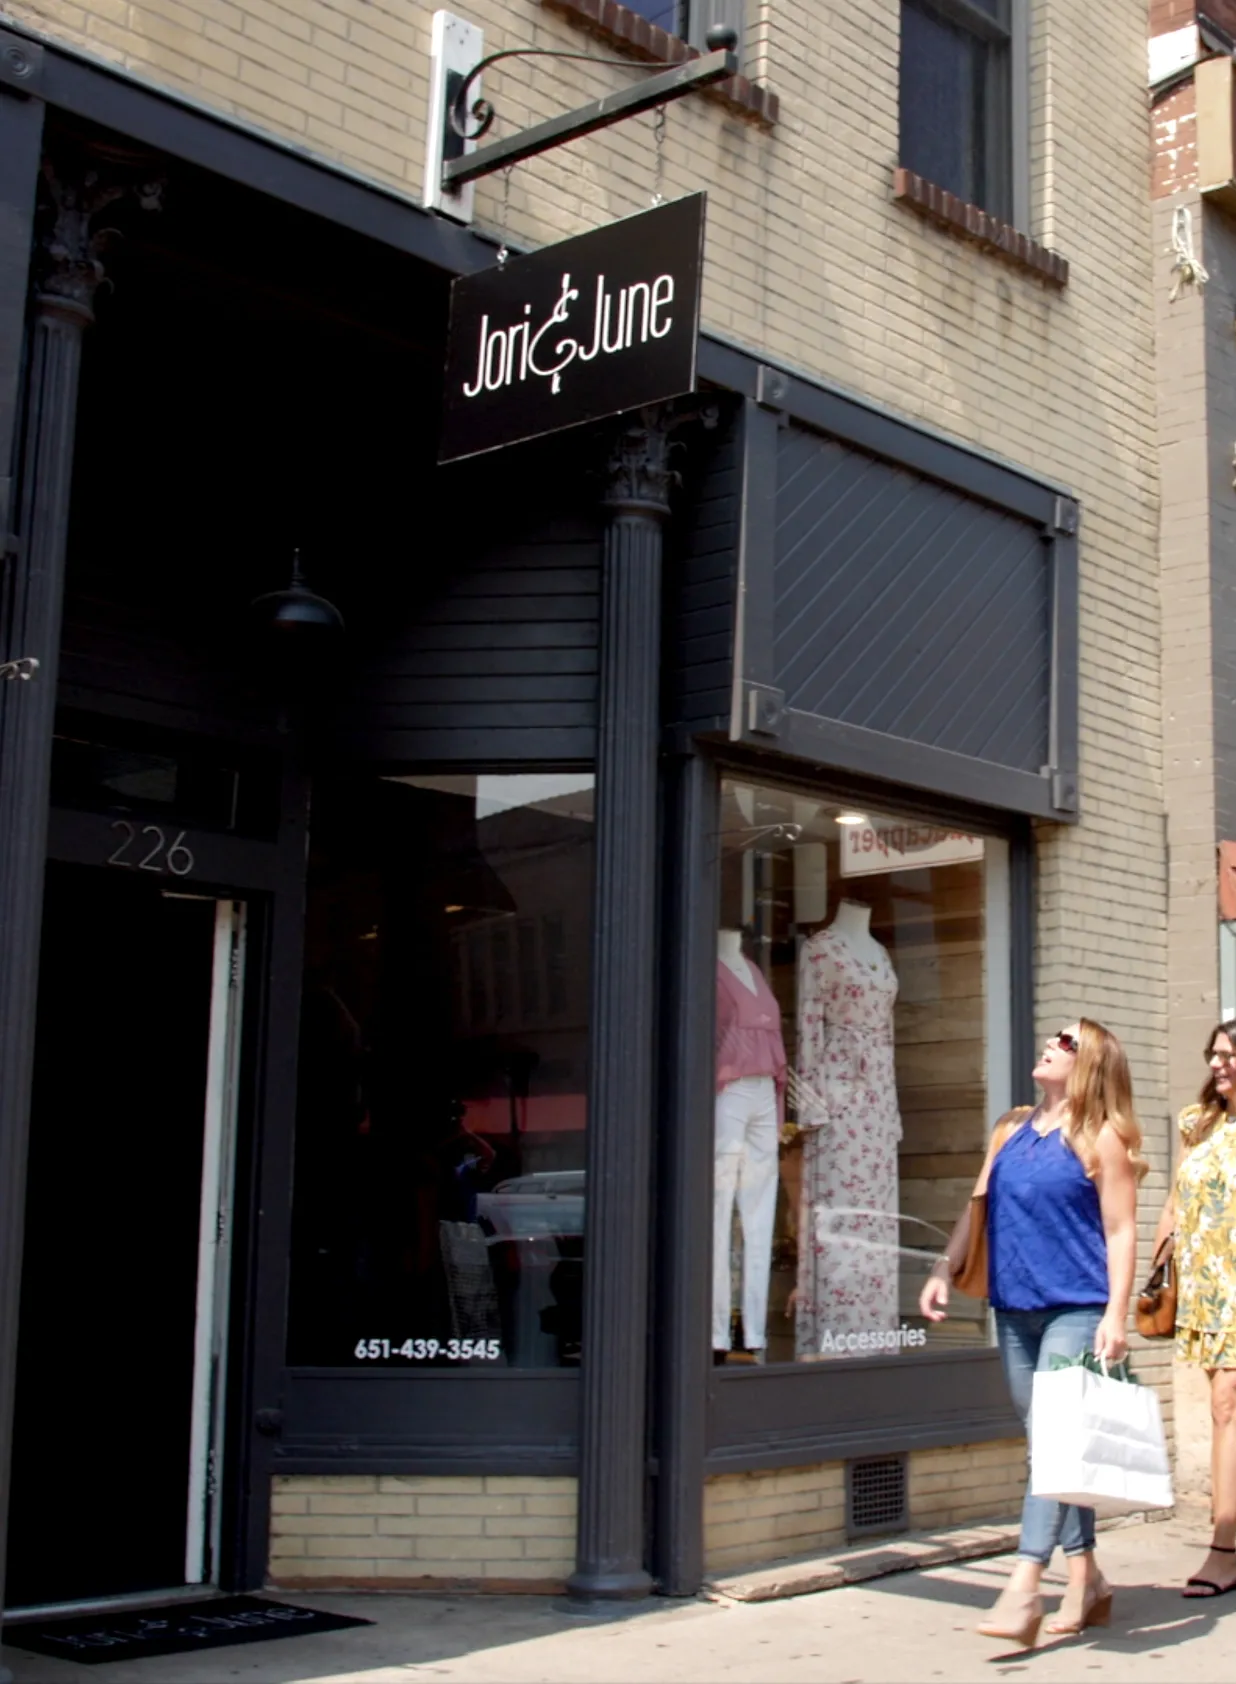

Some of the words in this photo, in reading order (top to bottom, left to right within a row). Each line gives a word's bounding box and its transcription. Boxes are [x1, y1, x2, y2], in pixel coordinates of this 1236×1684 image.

[463, 304, 531, 397] Jori
[578, 274, 674, 361] June
[107, 820, 194, 876] 226
[354, 1338, 500, 1360] 651-439-3545
[821, 1324, 927, 1353] Accessories
